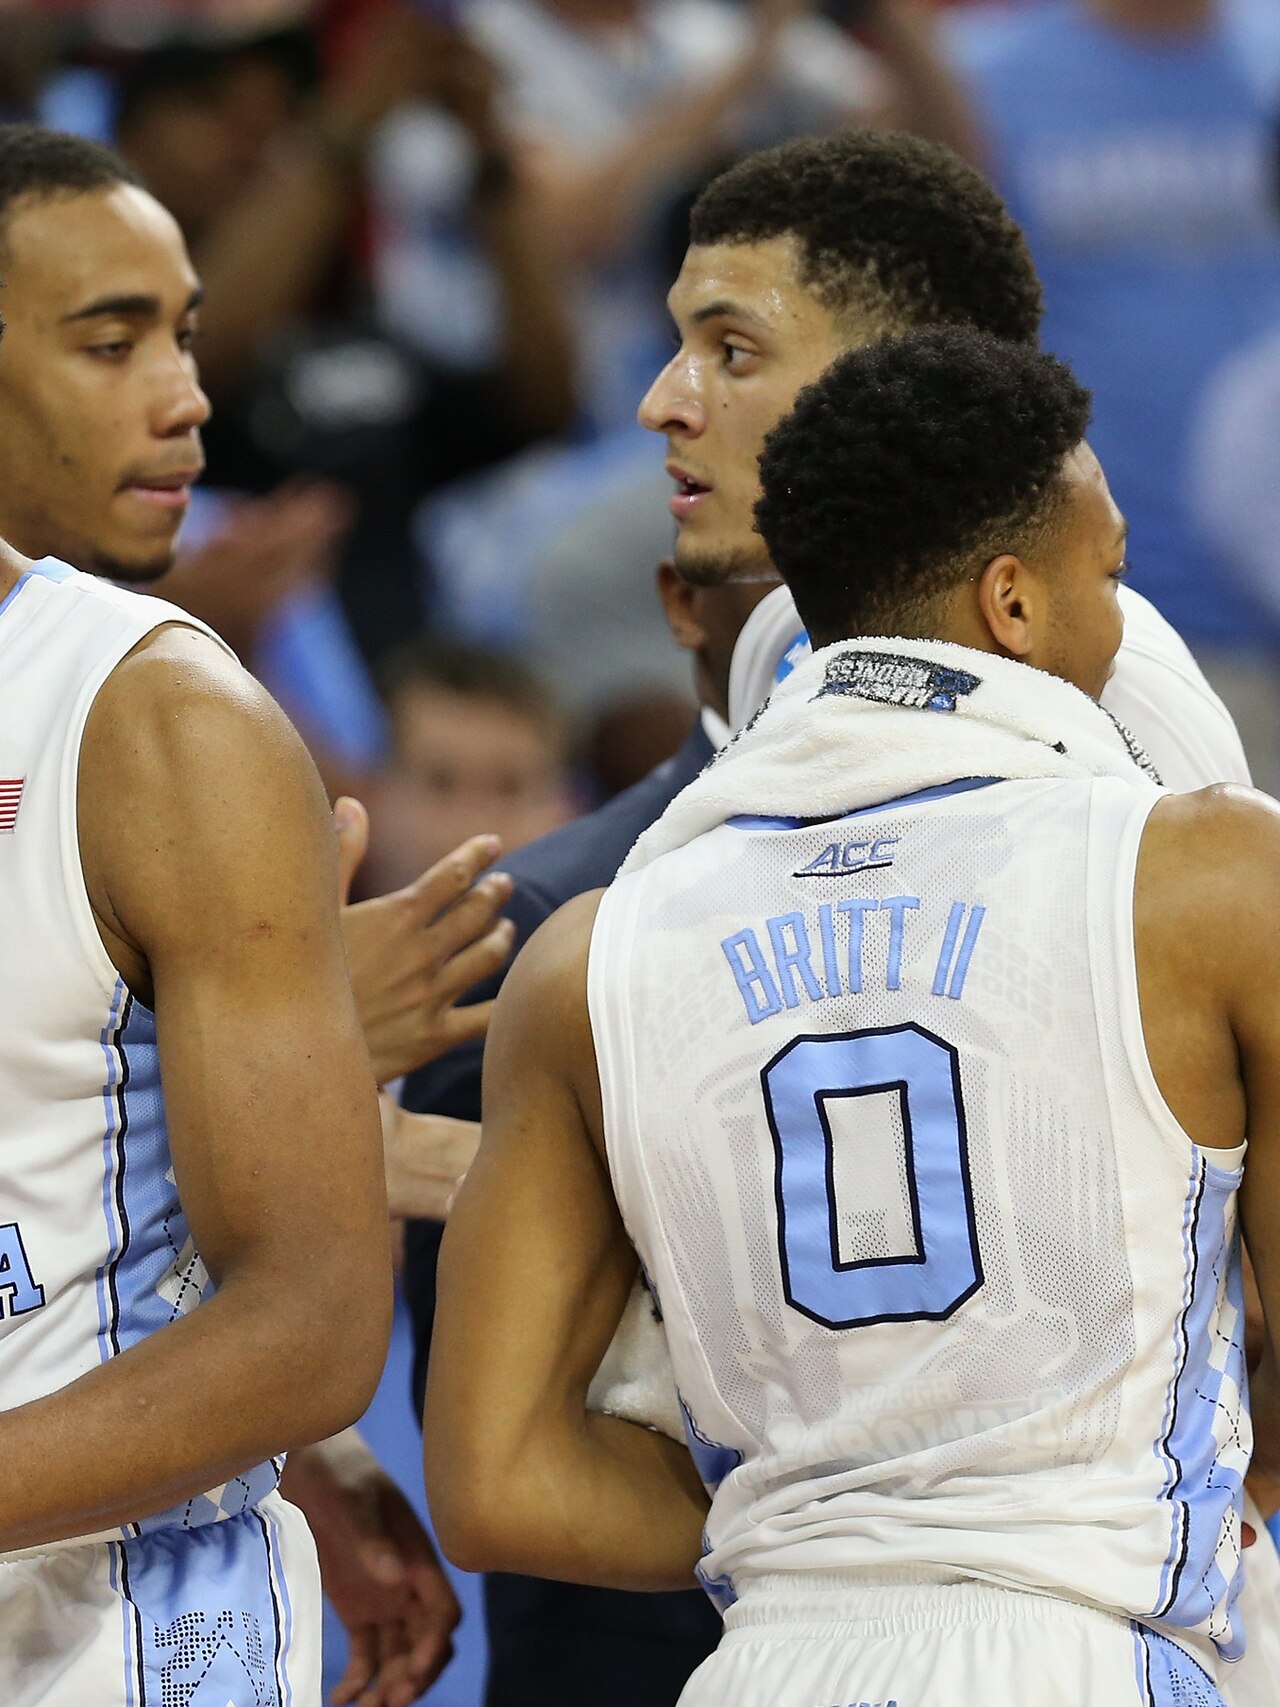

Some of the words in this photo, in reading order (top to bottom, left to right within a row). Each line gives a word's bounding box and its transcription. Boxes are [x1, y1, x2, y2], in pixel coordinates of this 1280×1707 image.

[802, 837, 903, 871] ACC
[720, 896, 920, 1021] BRITT
[931, 900, 988, 1001] II
[760, 1021, 985, 1331] 0
